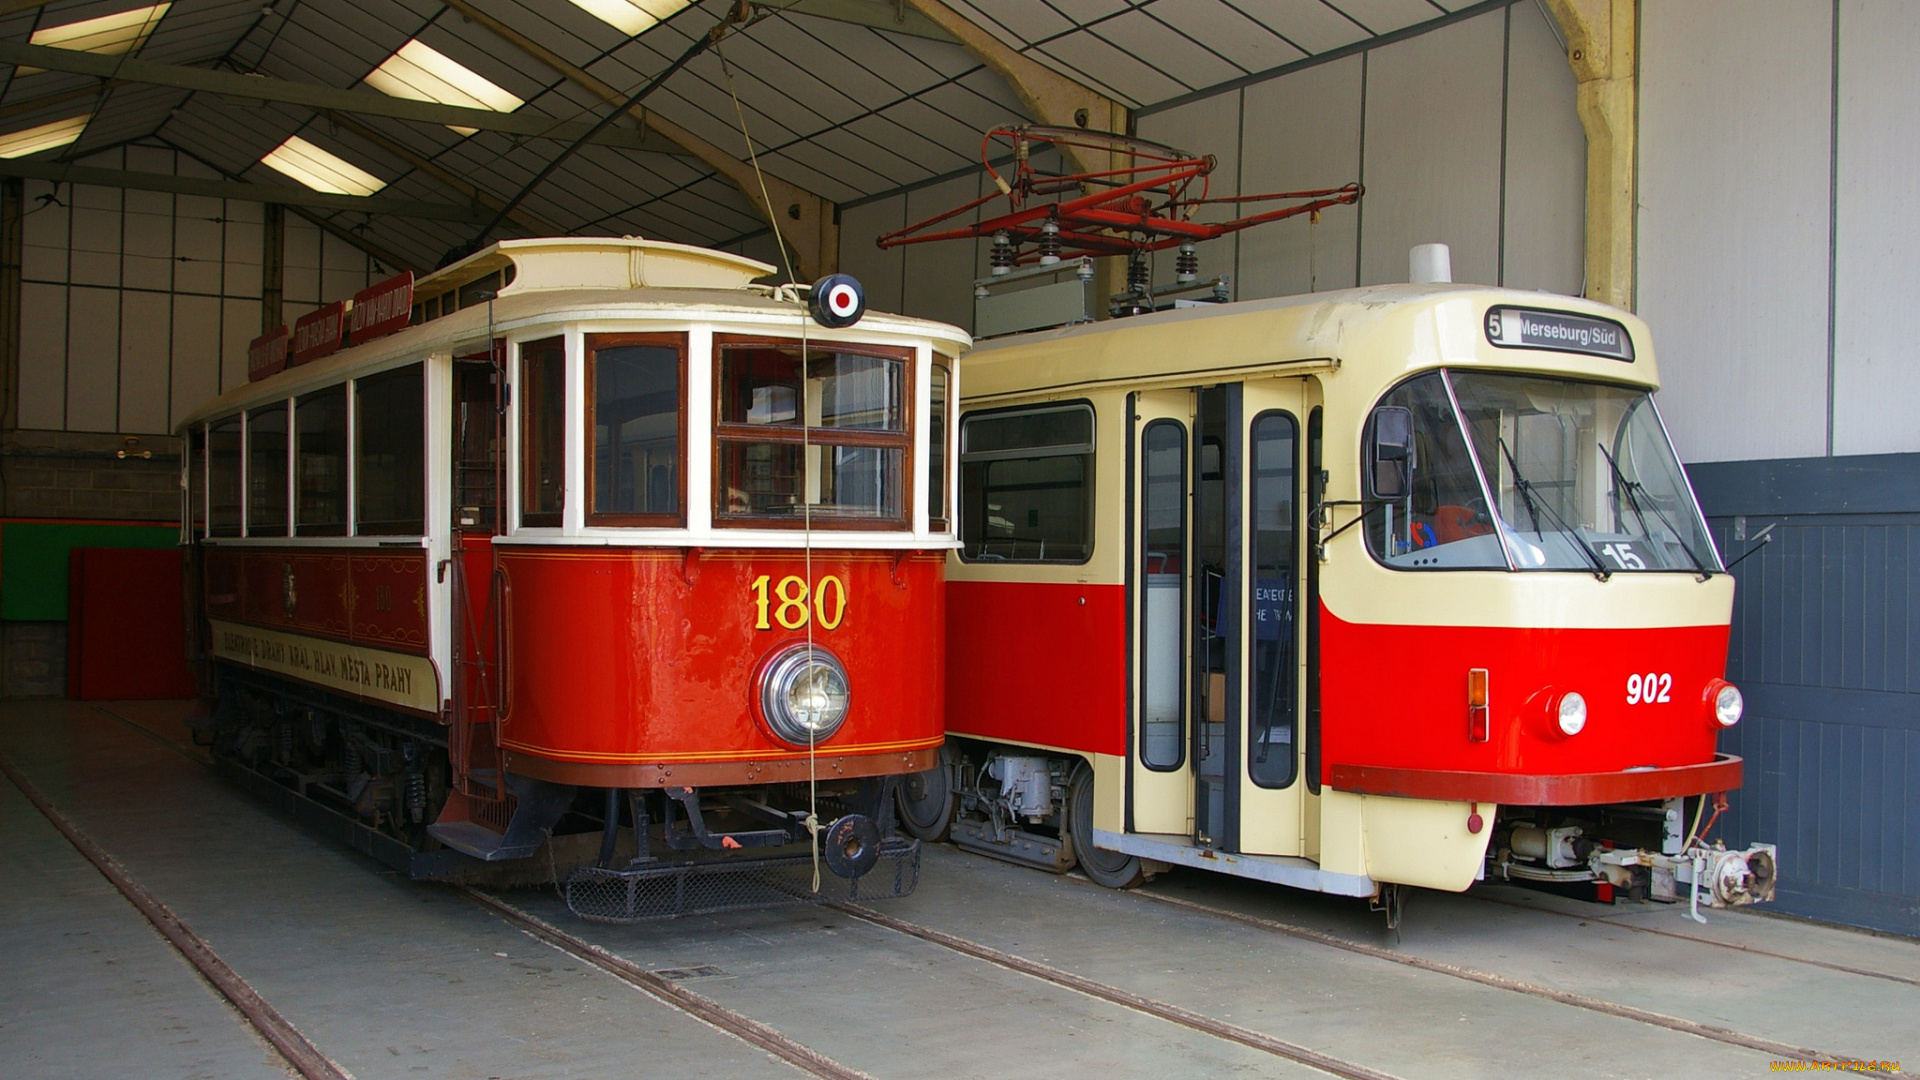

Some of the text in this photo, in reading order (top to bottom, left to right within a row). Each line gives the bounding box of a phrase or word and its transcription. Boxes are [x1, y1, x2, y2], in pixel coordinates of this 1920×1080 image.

[1520, 318, 1616, 346] Merseburg/Süd
[1602, 543, 1646, 570] 15
[751, 575, 847, 630] 180
[340, 654, 371, 686] MĚSTA
[375, 662, 411, 695] PRAHY
[1626, 673, 1672, 705] 902
